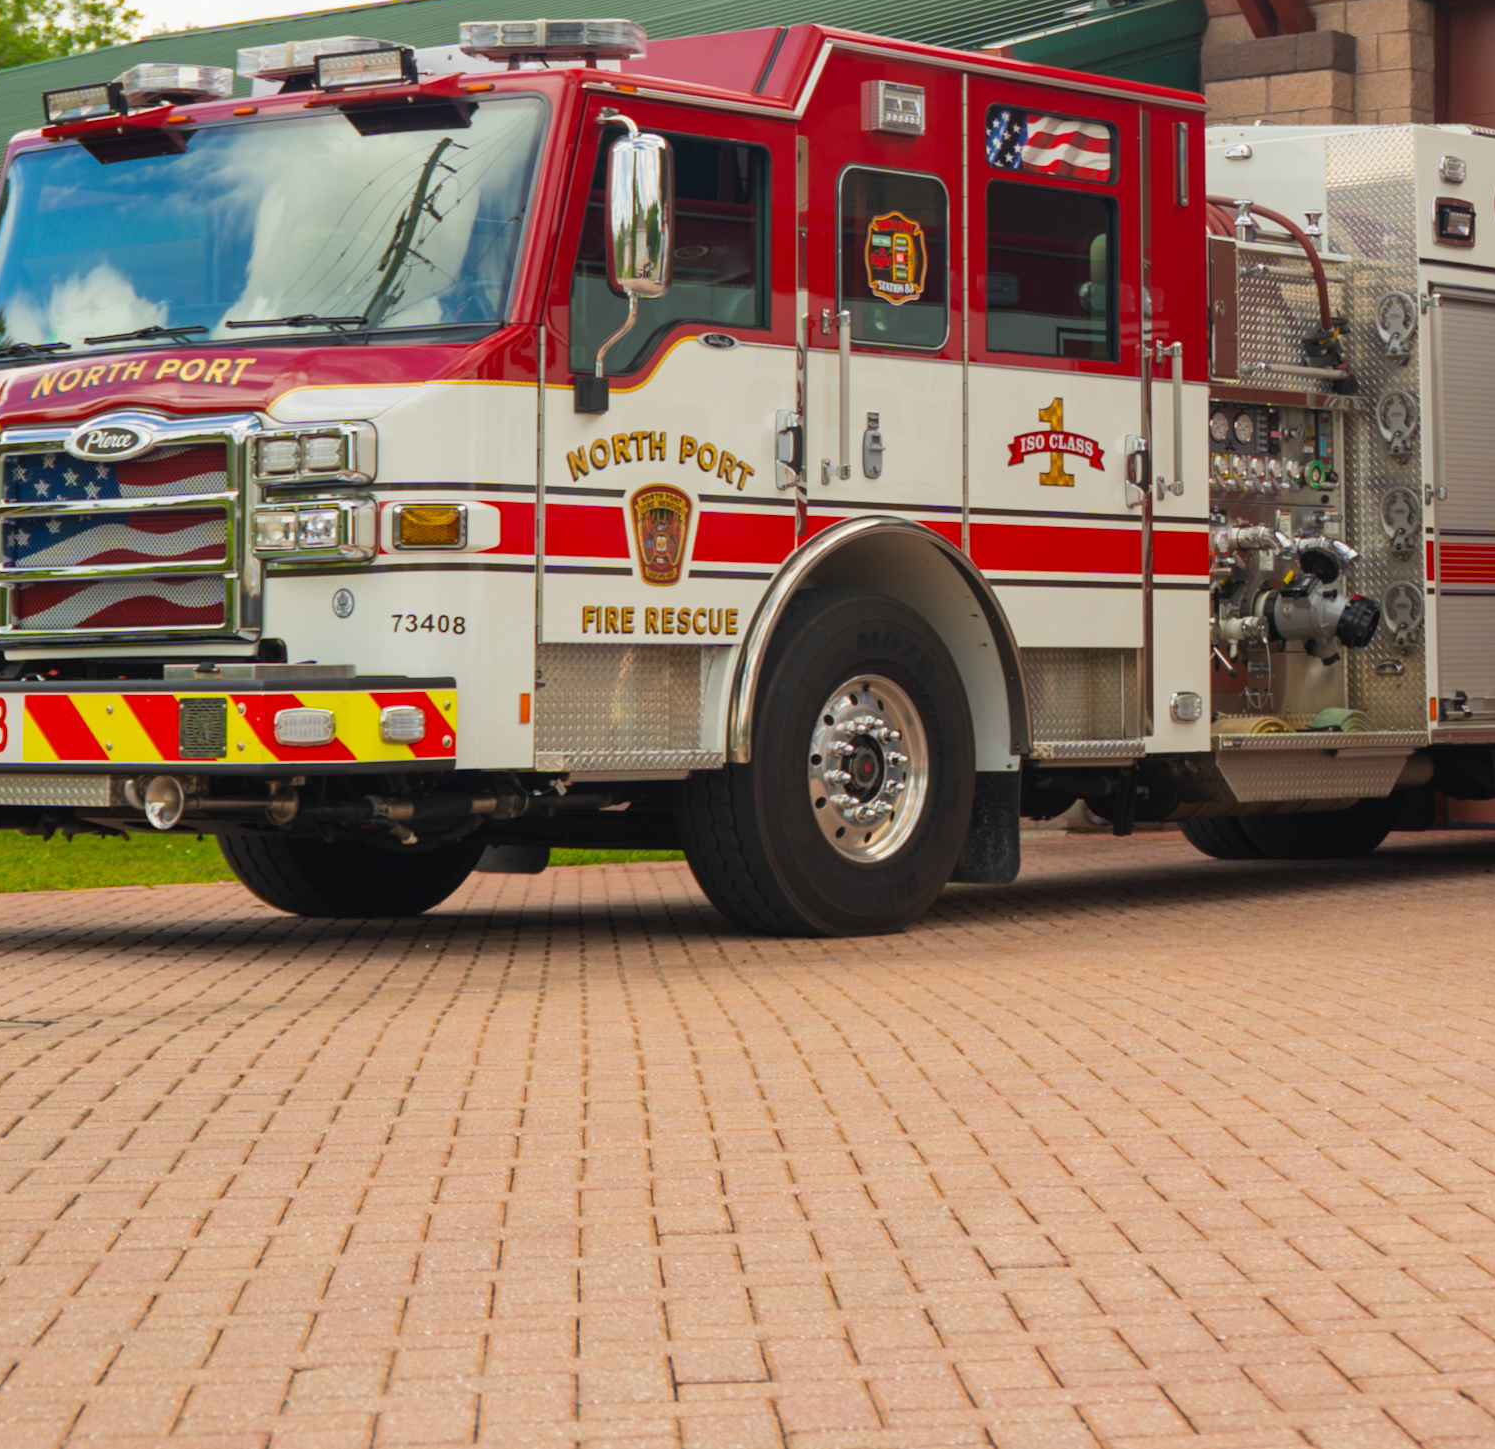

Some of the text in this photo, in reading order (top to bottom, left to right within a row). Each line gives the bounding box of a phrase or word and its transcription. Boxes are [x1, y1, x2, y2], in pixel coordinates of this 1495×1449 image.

[878, 279, 904, 293] STATION
[30, 358, 257, 401] NORTH PORT
[83, 430, 132, 452] Pierce
[1020, 433, 1094, 456] ISO CLASS
[566, 431, 755, 491] NORTH PORT
[390, 613, 466, 635] 73408
[582, 606, 739, 635] FIRE RESCUE
